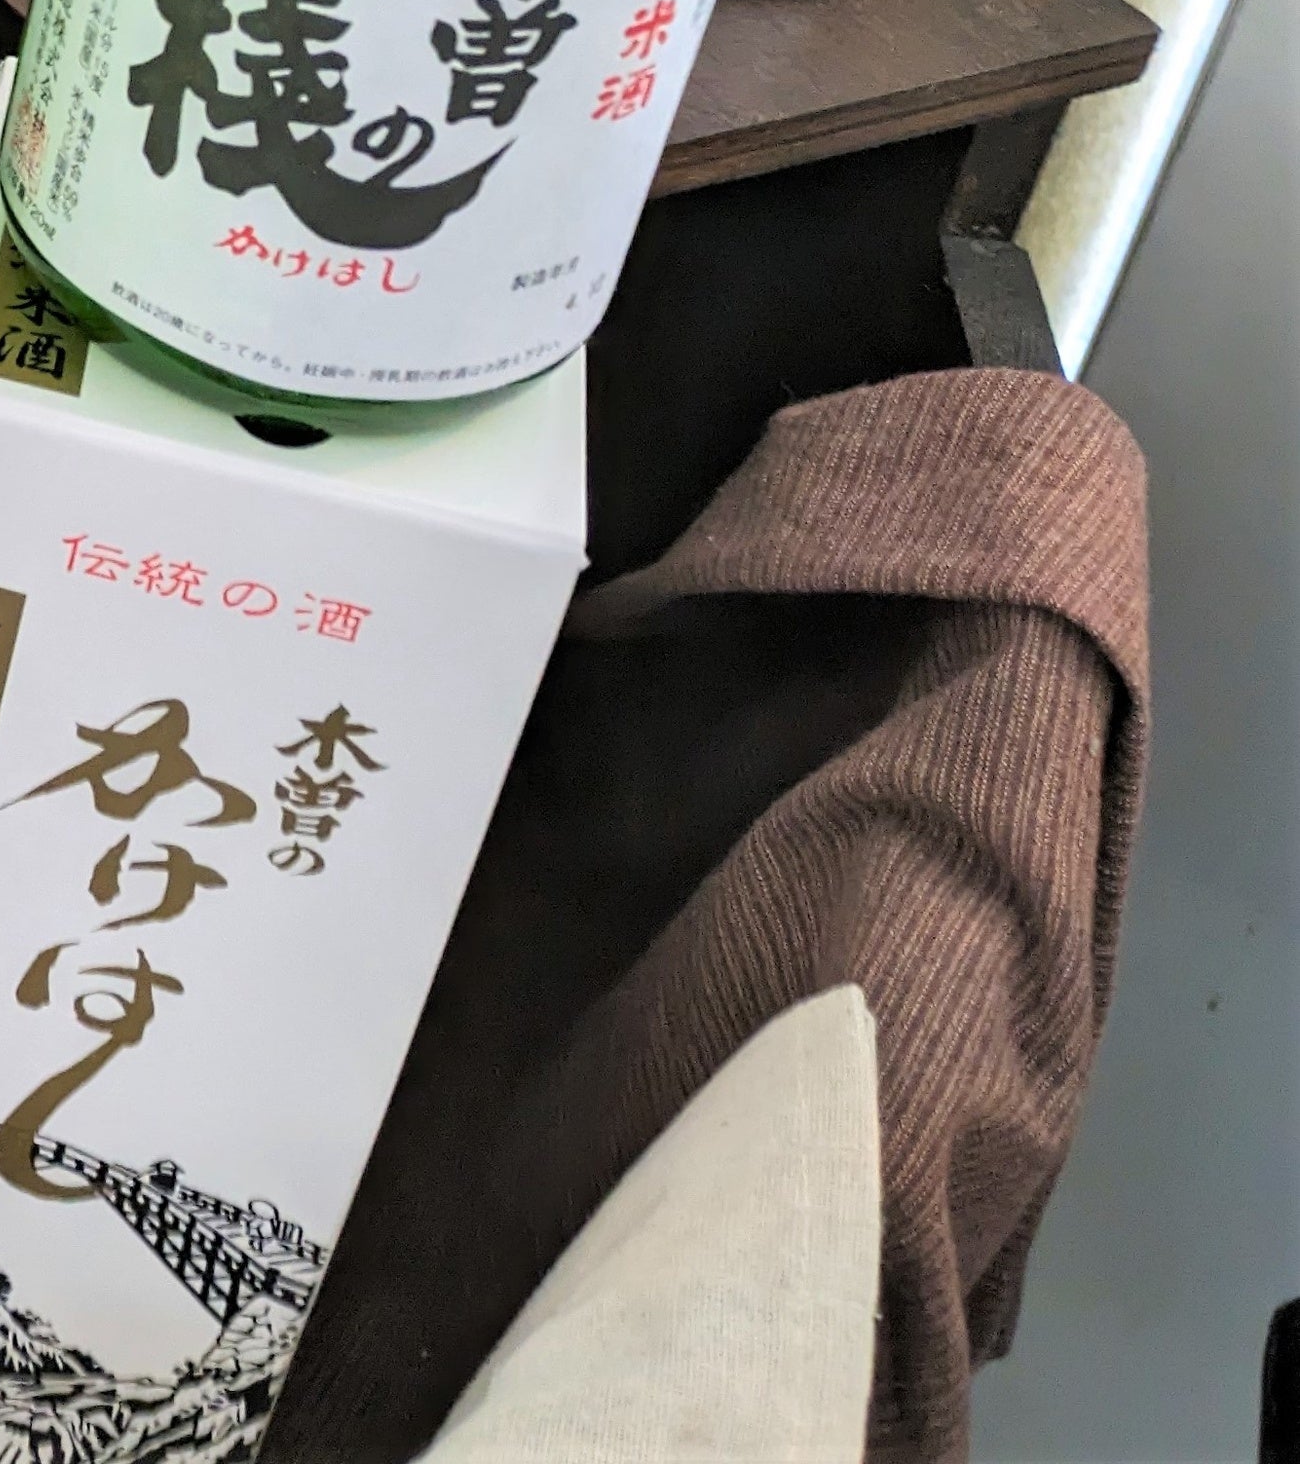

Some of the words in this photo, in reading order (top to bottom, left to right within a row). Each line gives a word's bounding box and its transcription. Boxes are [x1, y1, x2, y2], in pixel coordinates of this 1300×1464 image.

[215, 225, 421, 294] かけはし
[61, 532, 373, 645] 伝統の酒
[0, 699, 257, 1204] かけはし
